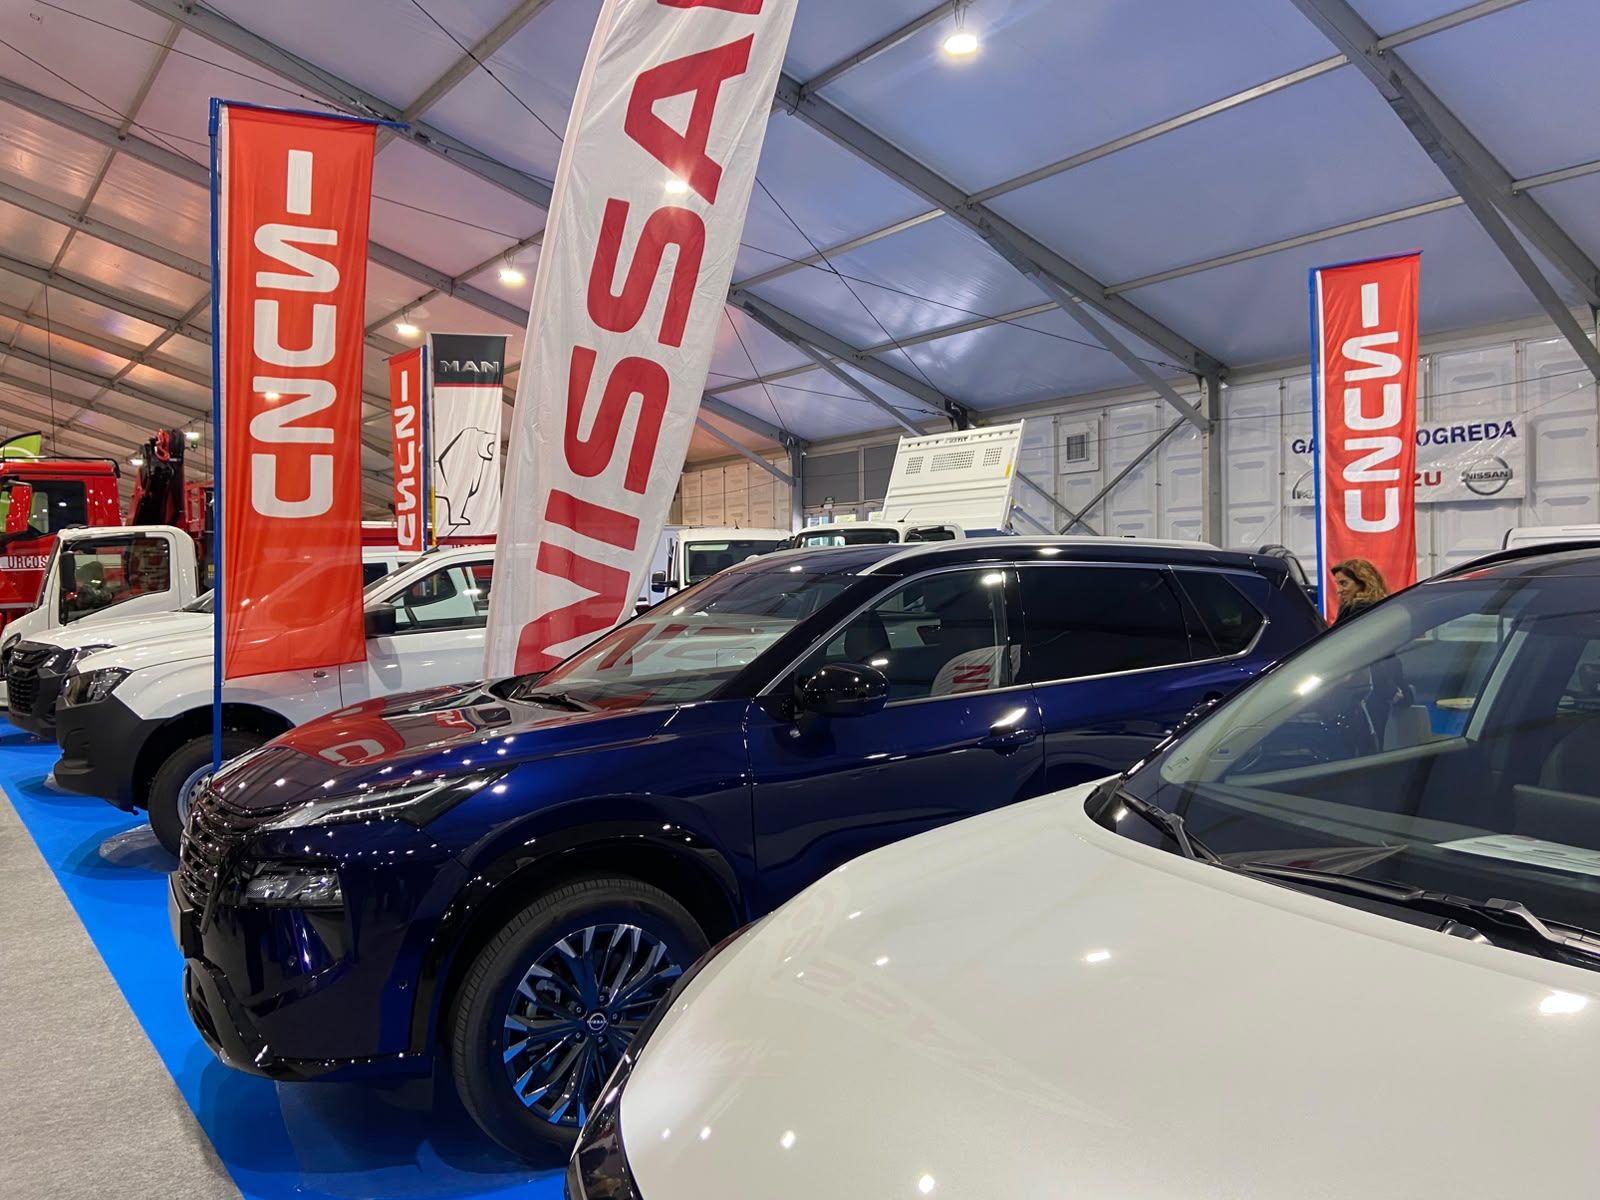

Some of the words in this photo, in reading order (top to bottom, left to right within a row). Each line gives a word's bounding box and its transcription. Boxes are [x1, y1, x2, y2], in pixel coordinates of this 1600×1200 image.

[250, 148, 341, 519] ISUZU
[440, 360, 500, 374] MAN
[513, 0, 766, 675] NISSA
[1341, 281, 1403, 534] ISUZU
[1415, 420, 1517, 447] OGREDA
[1465, 470, 1509, 480] NISSAN
